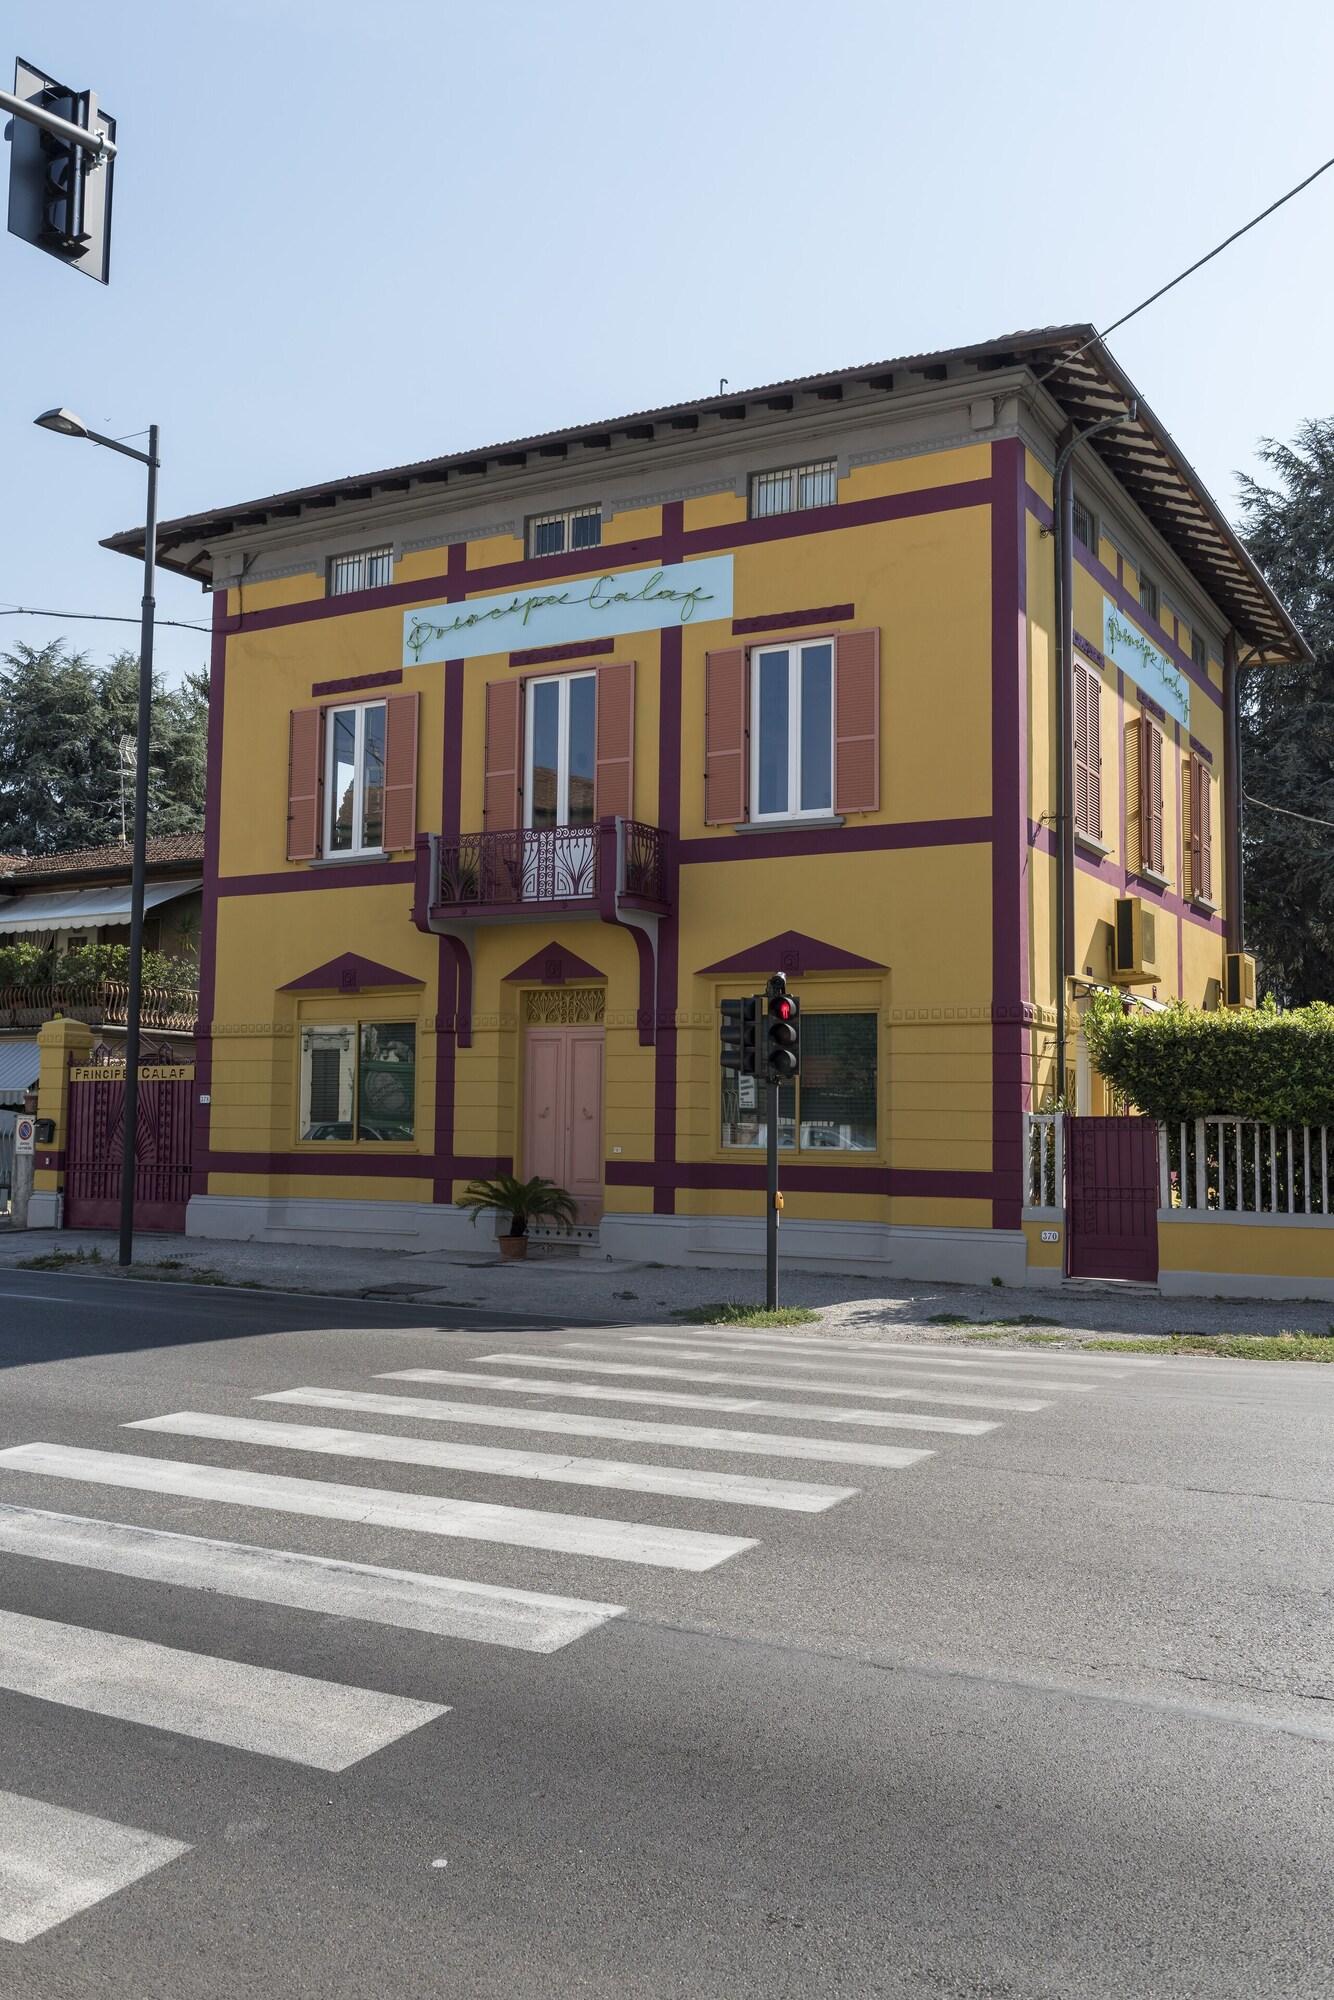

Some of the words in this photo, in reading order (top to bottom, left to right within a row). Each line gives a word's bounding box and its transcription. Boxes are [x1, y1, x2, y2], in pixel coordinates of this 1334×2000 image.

[589, 571, 714, 621] Calaf
[142, 1067, 185, 1079] CALAF
[1042, 1232, 1057, 1241] 370
